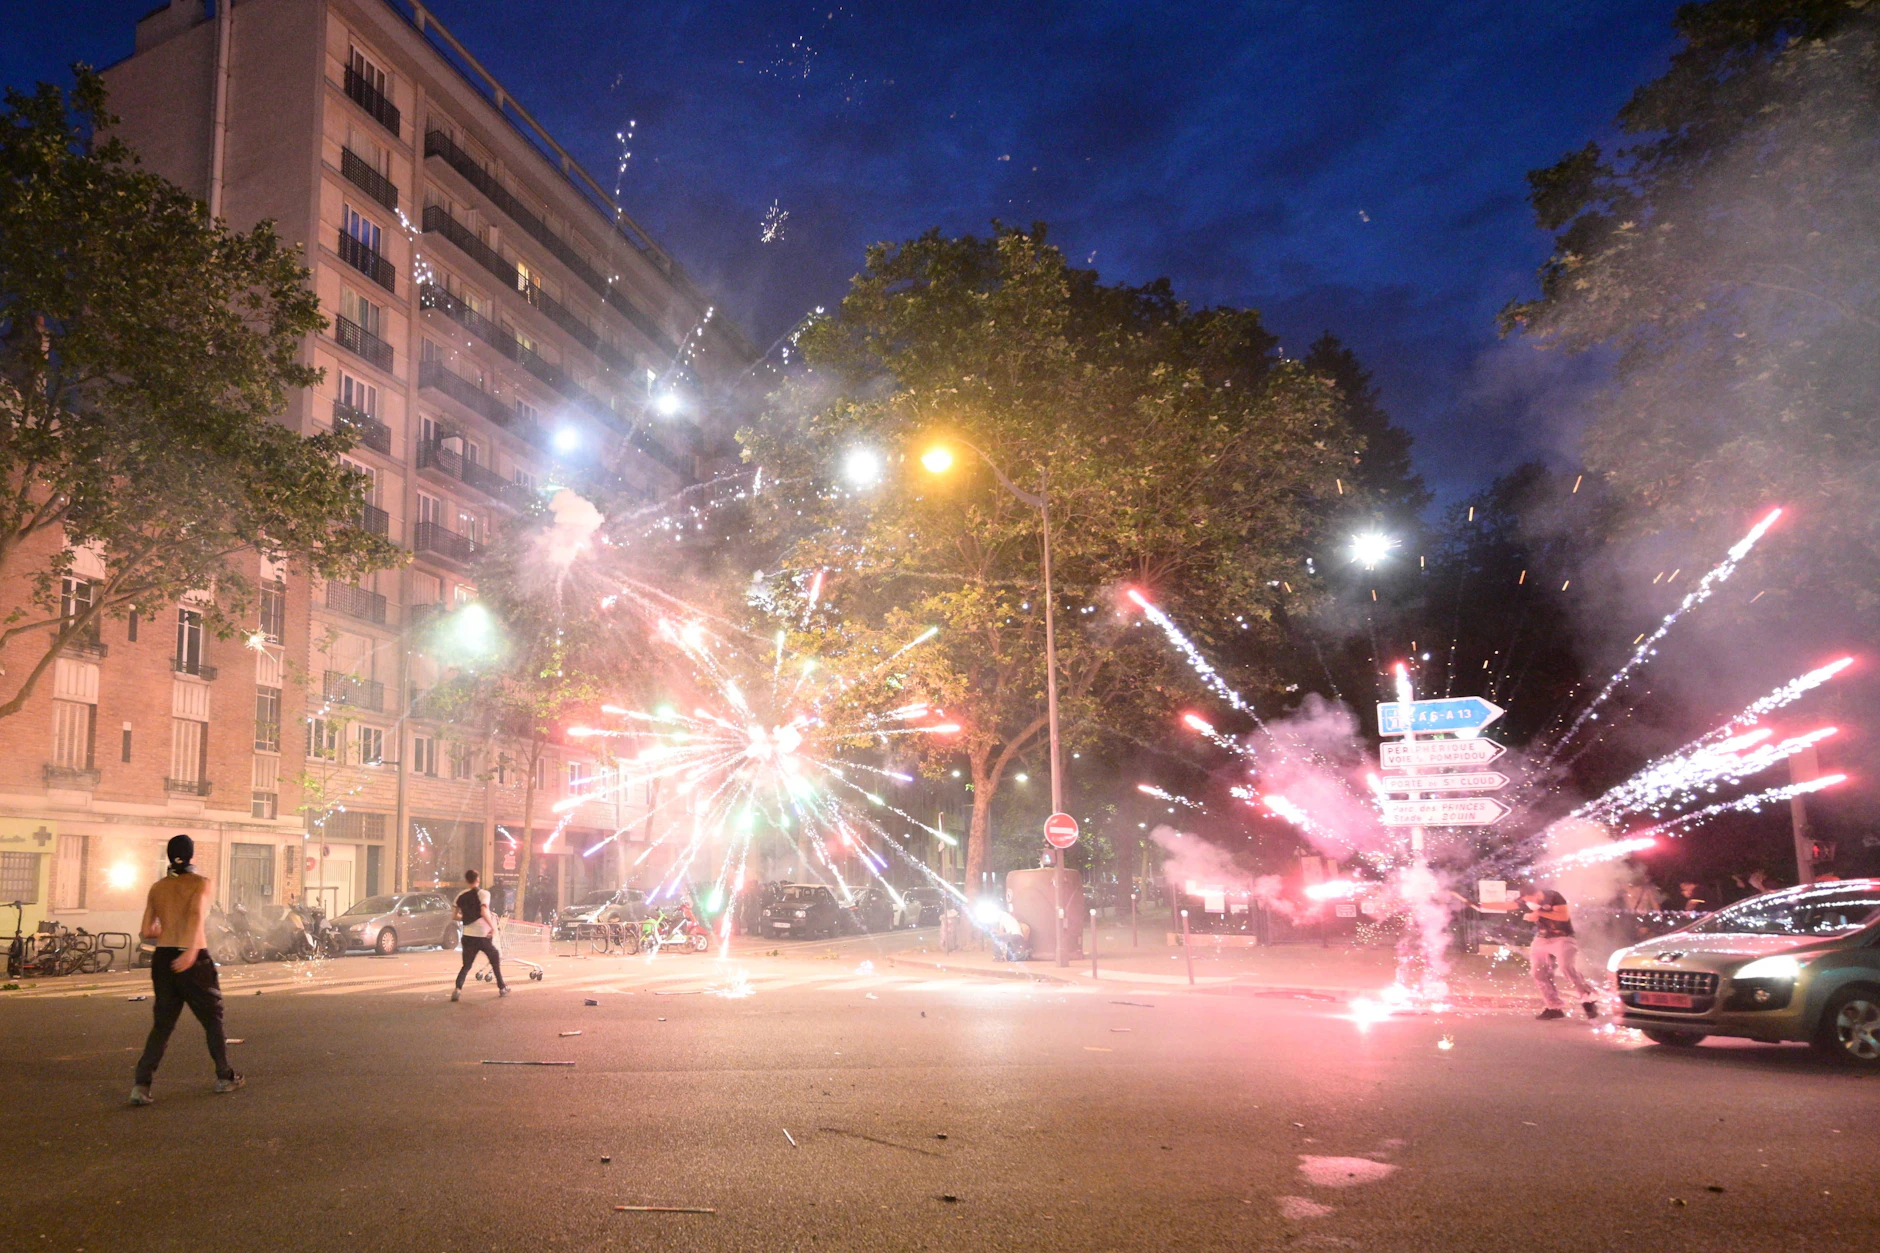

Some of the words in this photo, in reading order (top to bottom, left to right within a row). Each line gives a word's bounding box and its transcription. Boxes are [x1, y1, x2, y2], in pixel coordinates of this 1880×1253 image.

[1388, 755, 1412, 764] VOIE
[1429, 752, 1486, 762] POMPIDOU
[1391, 779, 1423, 788] PORTE
[1460, 776, 1495, 786] CLOUD
[1441, 802, 1486, 812] PRINCES
